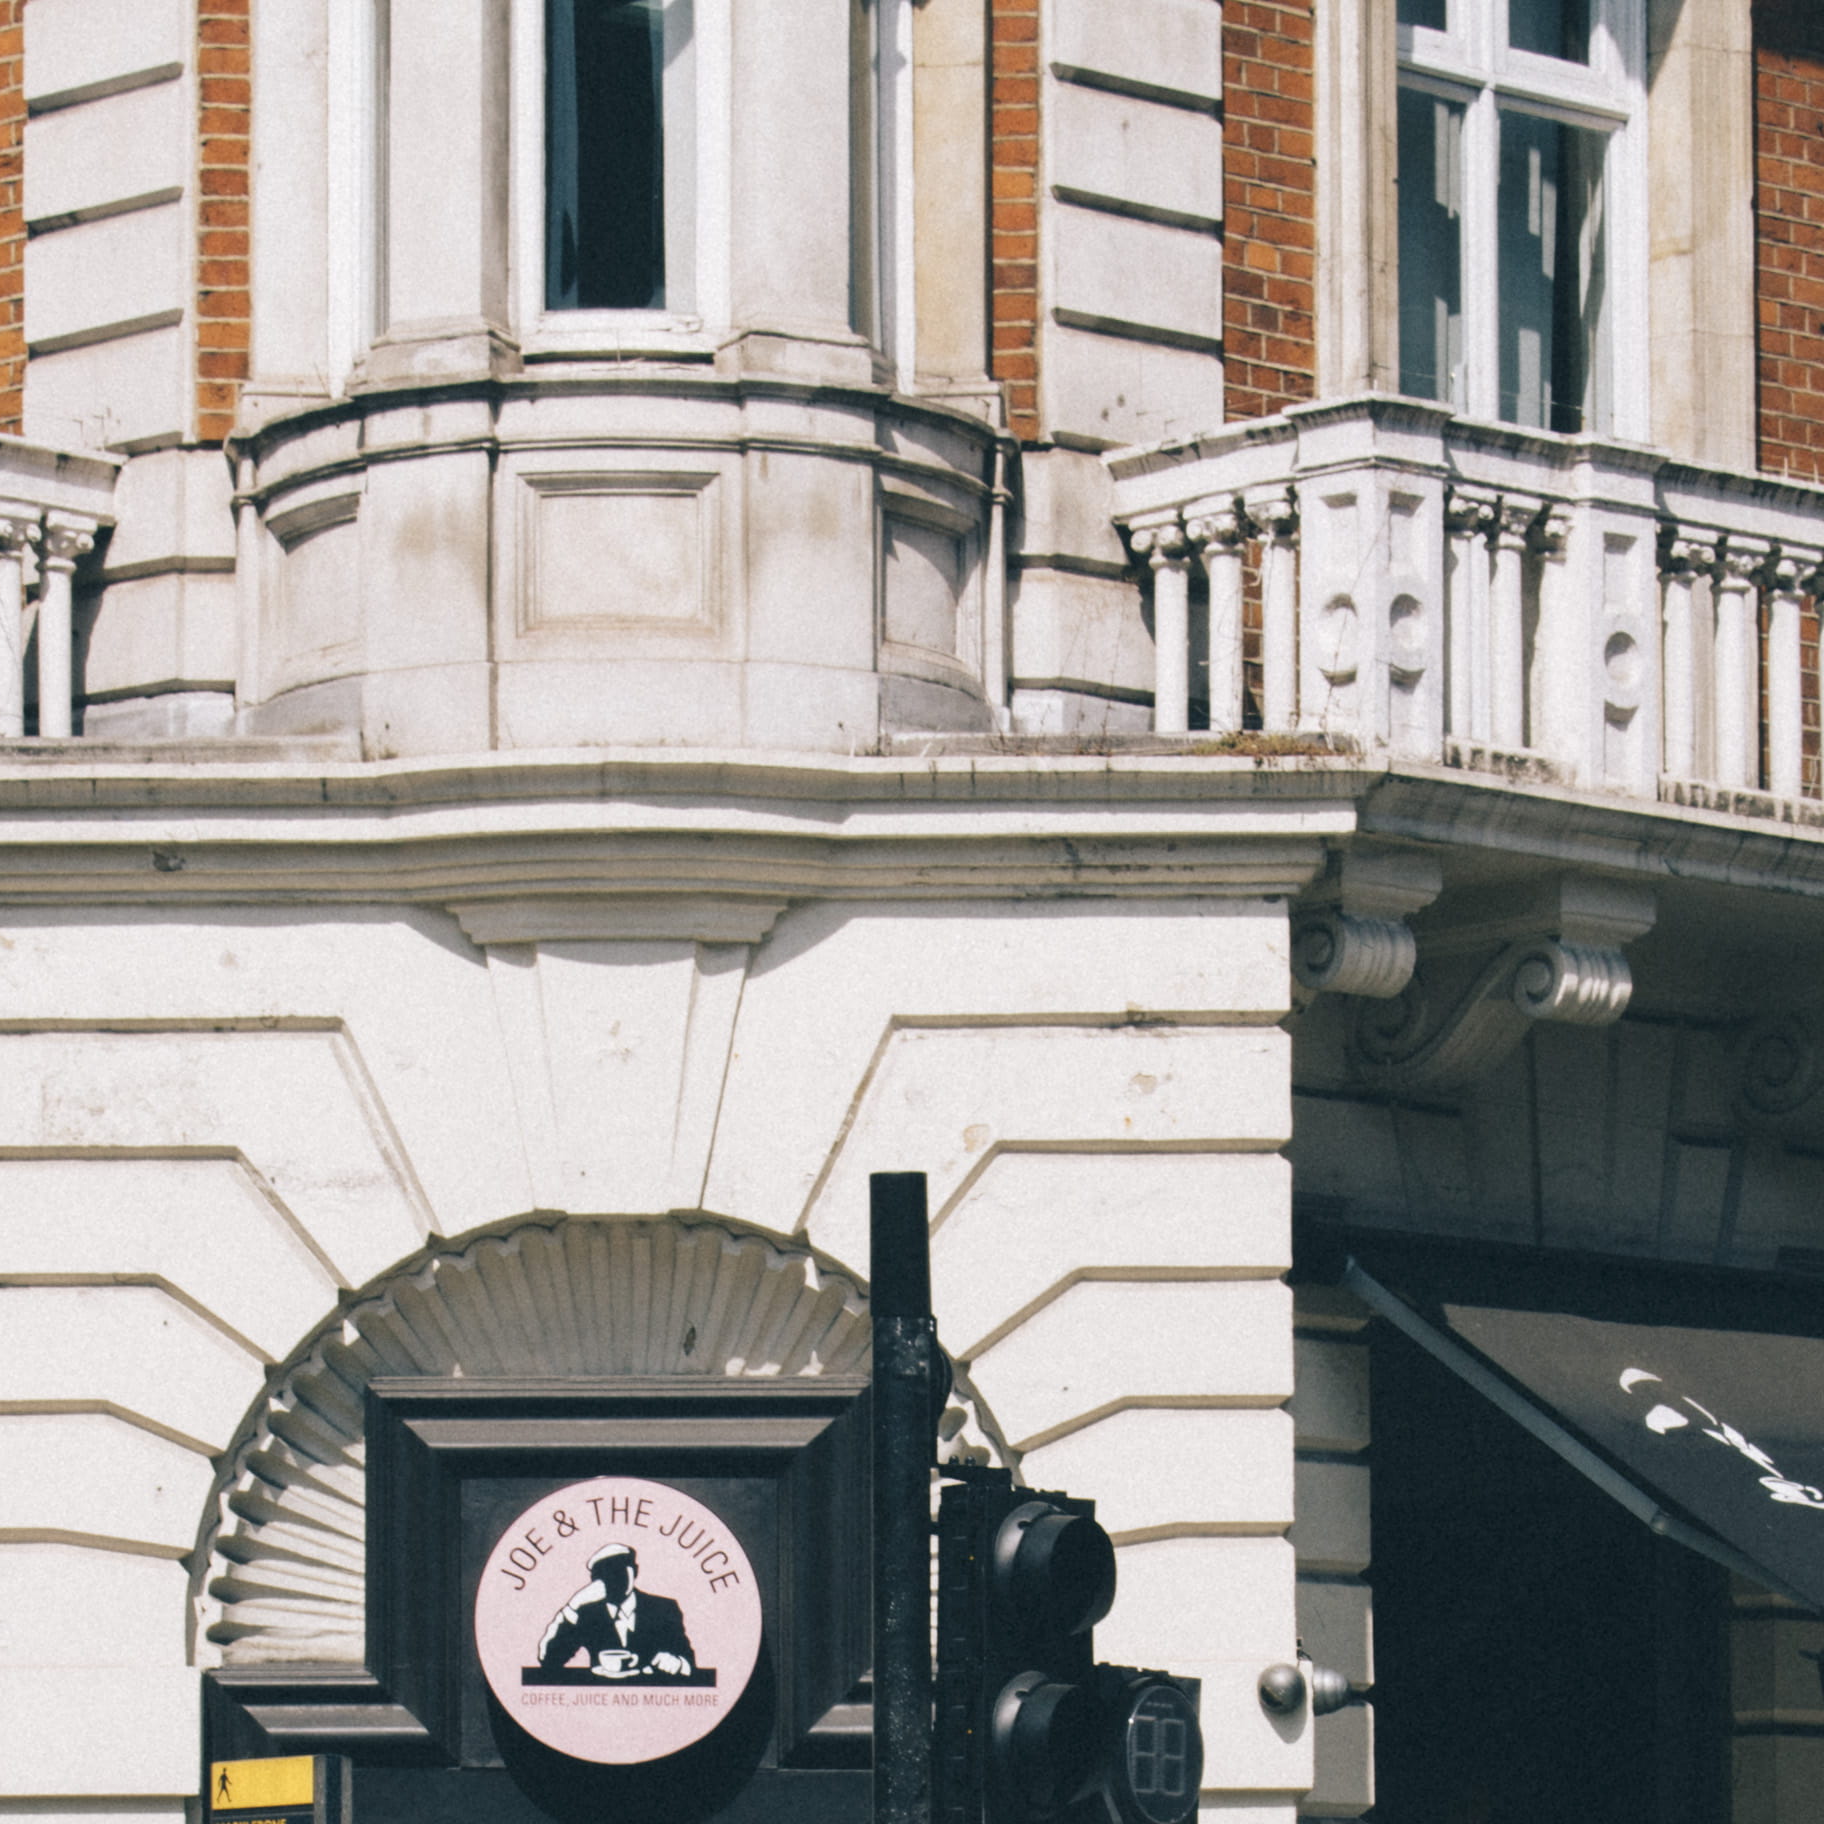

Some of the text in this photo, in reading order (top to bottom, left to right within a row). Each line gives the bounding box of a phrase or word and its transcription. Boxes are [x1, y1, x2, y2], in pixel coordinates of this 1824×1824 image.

[500, 1496, 741, 1593] JOE & THE JUICE
[521, 1693, 718, 1707] COFFEE, JUICE AND MUCH MORE
